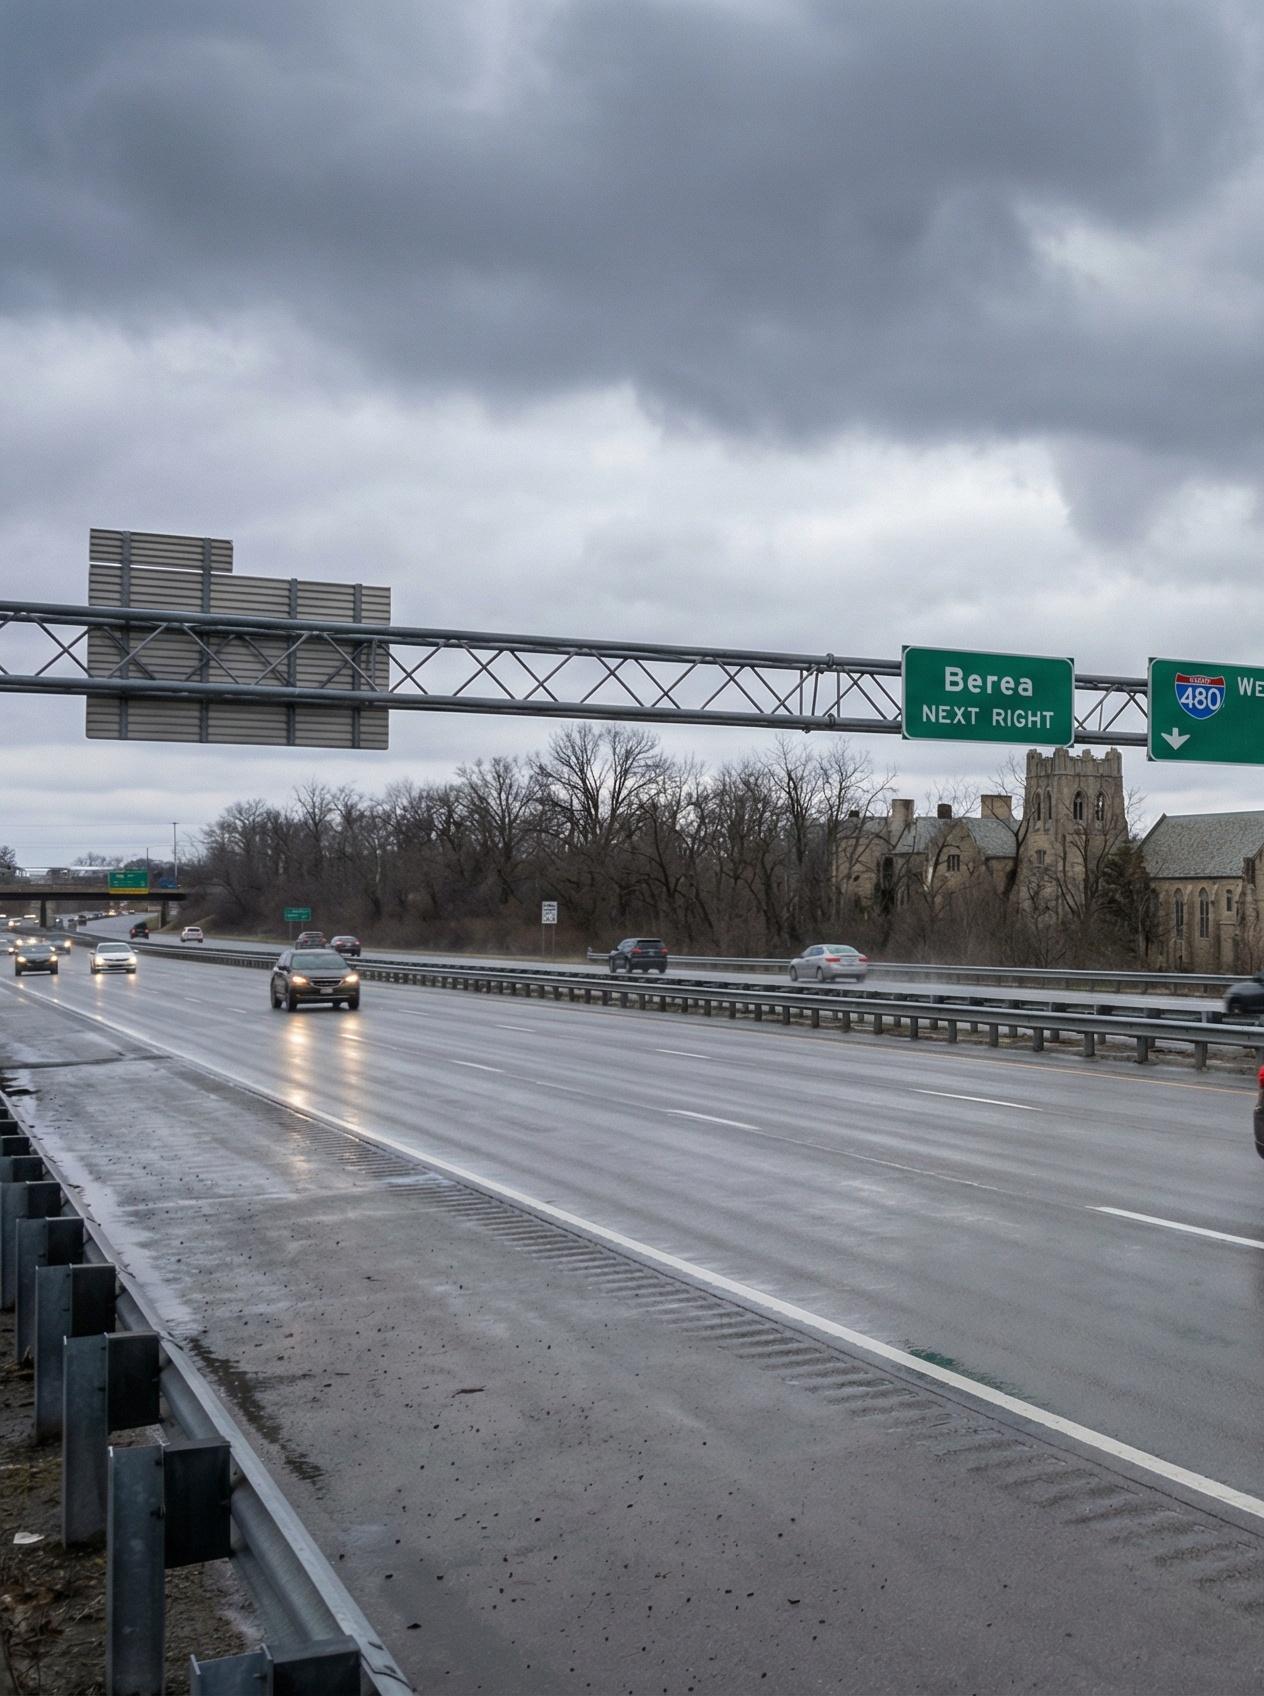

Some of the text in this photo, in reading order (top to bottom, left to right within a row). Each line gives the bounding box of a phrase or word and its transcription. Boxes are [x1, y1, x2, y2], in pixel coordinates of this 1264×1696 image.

[944, 666, 1033, 697] Berea
[1180, 687, 1220, 711] 480
[922, 704, 1054, 729] NEXT RIGHT
